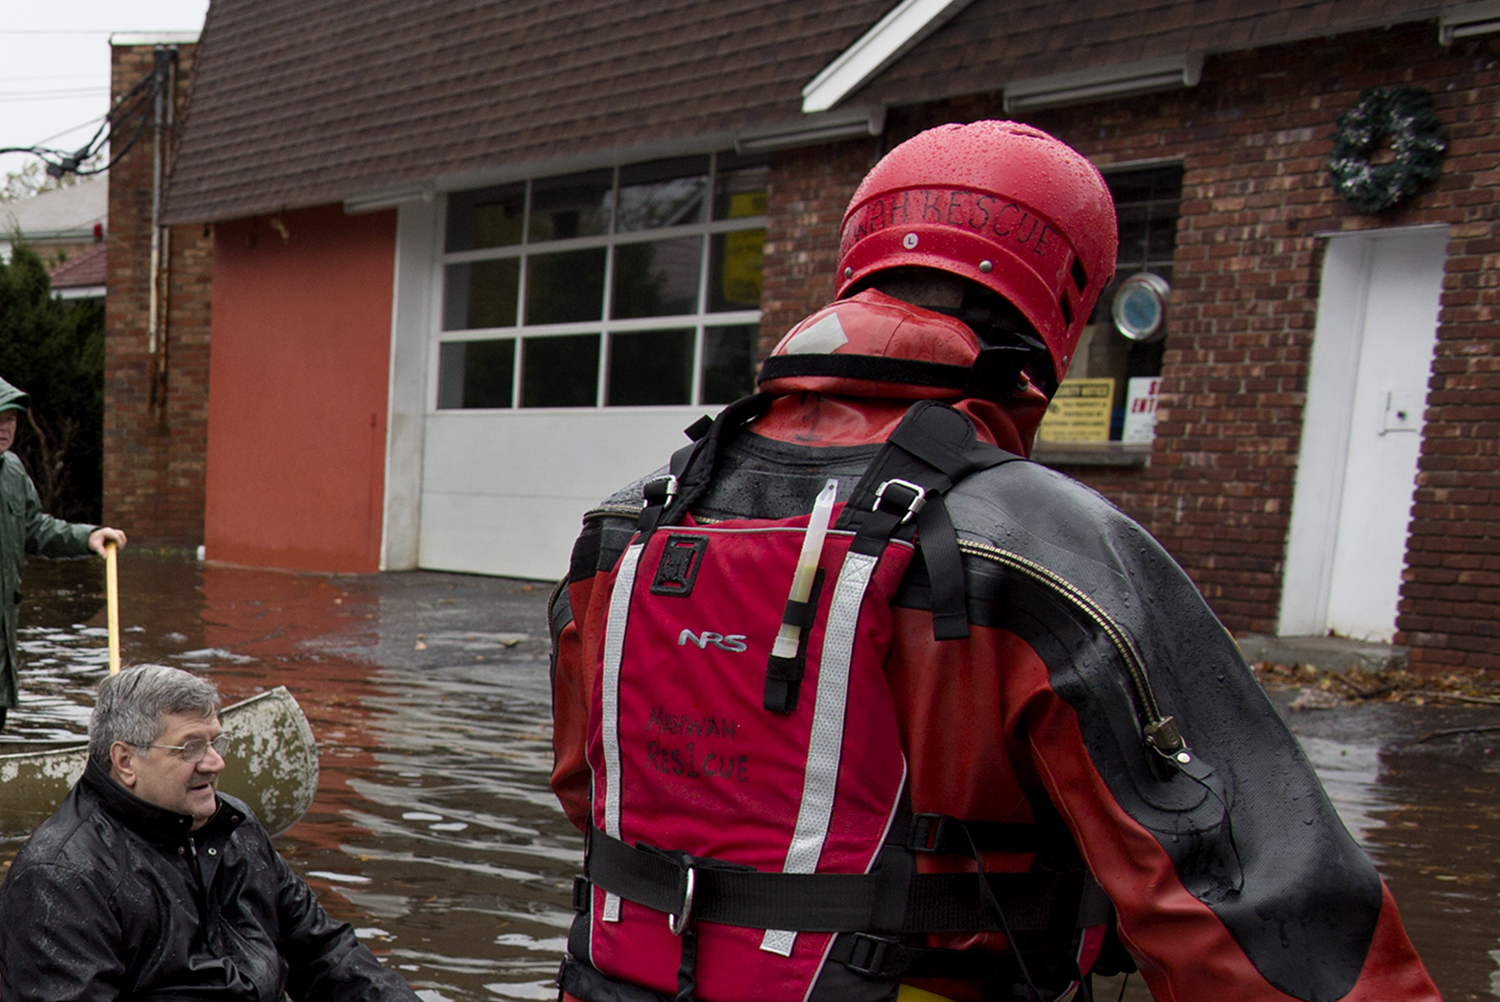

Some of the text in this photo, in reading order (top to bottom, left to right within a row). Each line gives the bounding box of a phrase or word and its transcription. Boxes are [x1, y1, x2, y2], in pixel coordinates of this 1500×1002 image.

[922, 190, 1059, 256] RESCUE
[677, 628, 748, 653] NRS
[646, 706, 736, 741] MAHWAH
